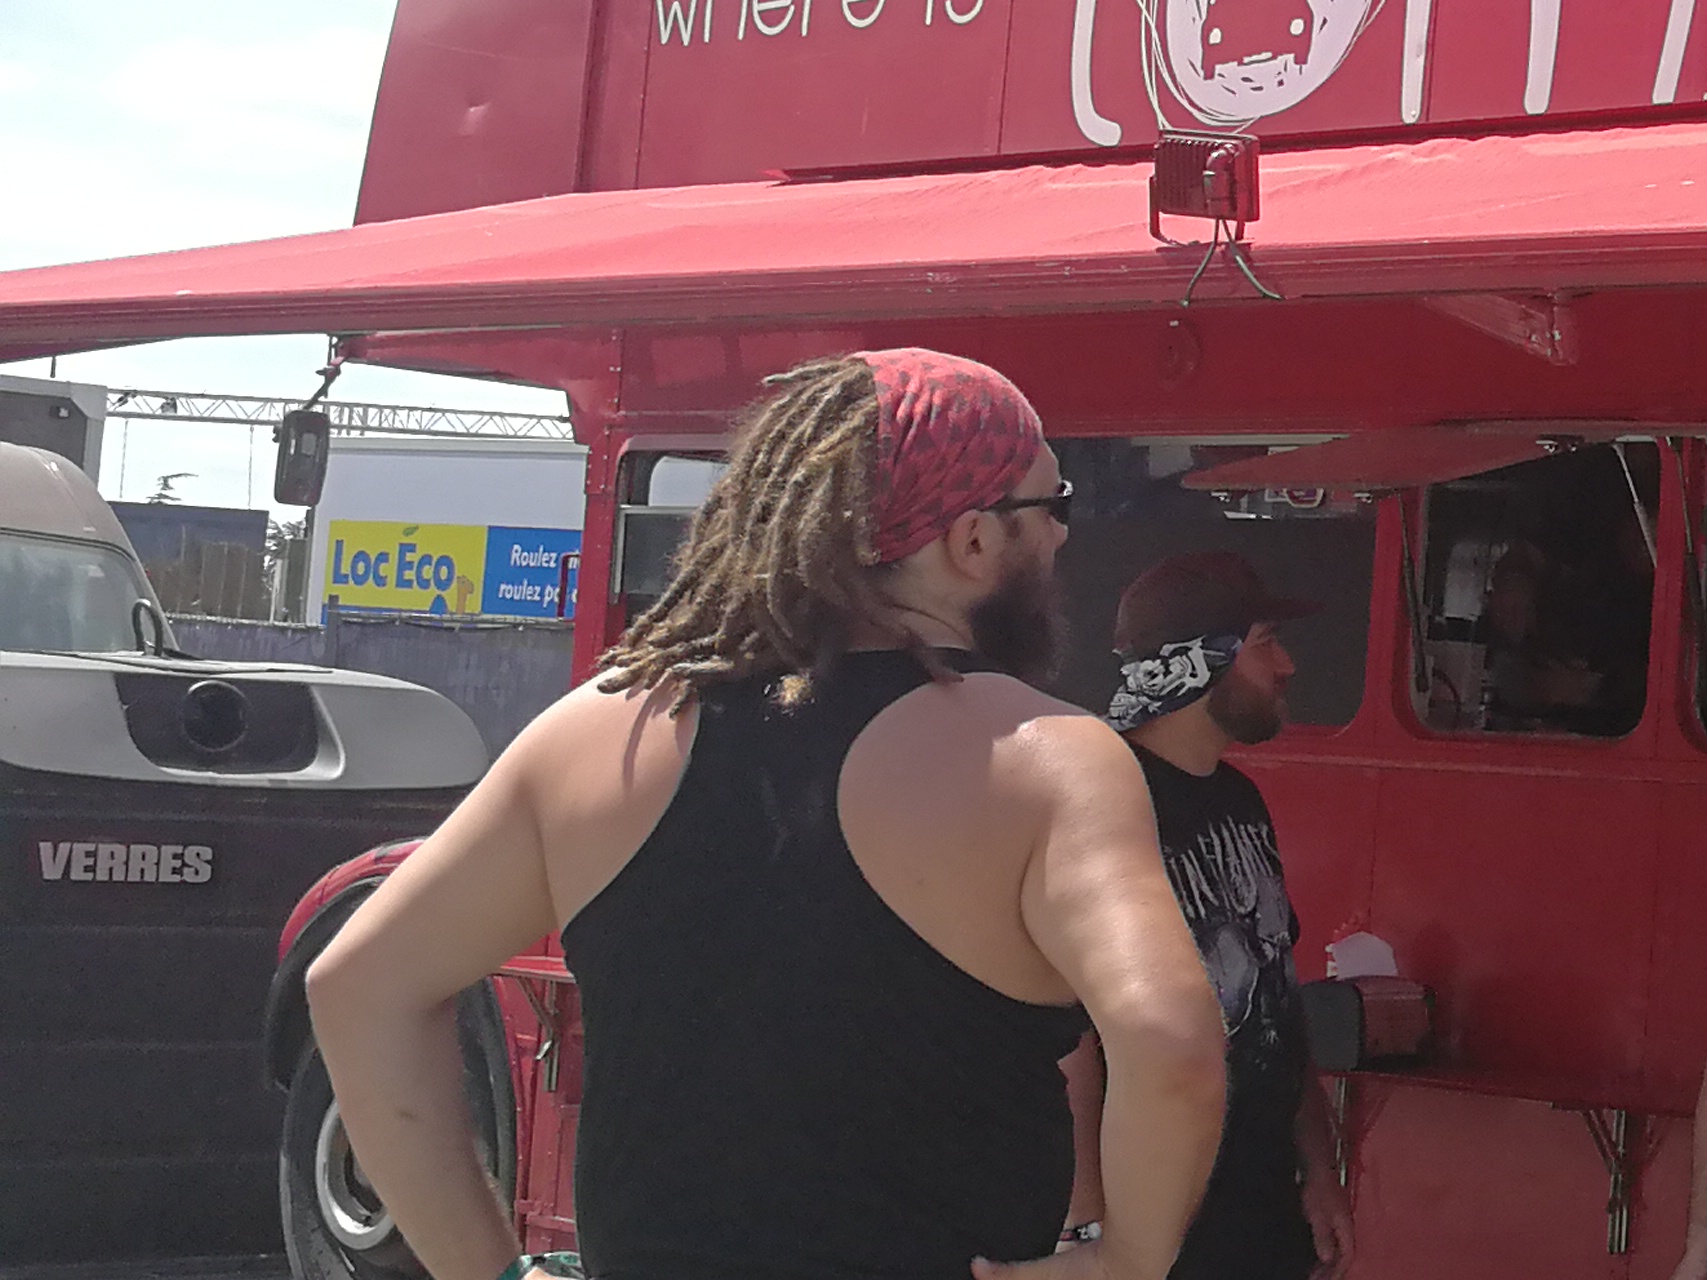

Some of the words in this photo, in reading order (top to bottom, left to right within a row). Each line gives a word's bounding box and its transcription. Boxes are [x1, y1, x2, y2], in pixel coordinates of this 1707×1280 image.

[511, 543, 557, 569] Roulez
[498, 578, 541, 602] roulez
[38, 841, 213, 883] VERRES
